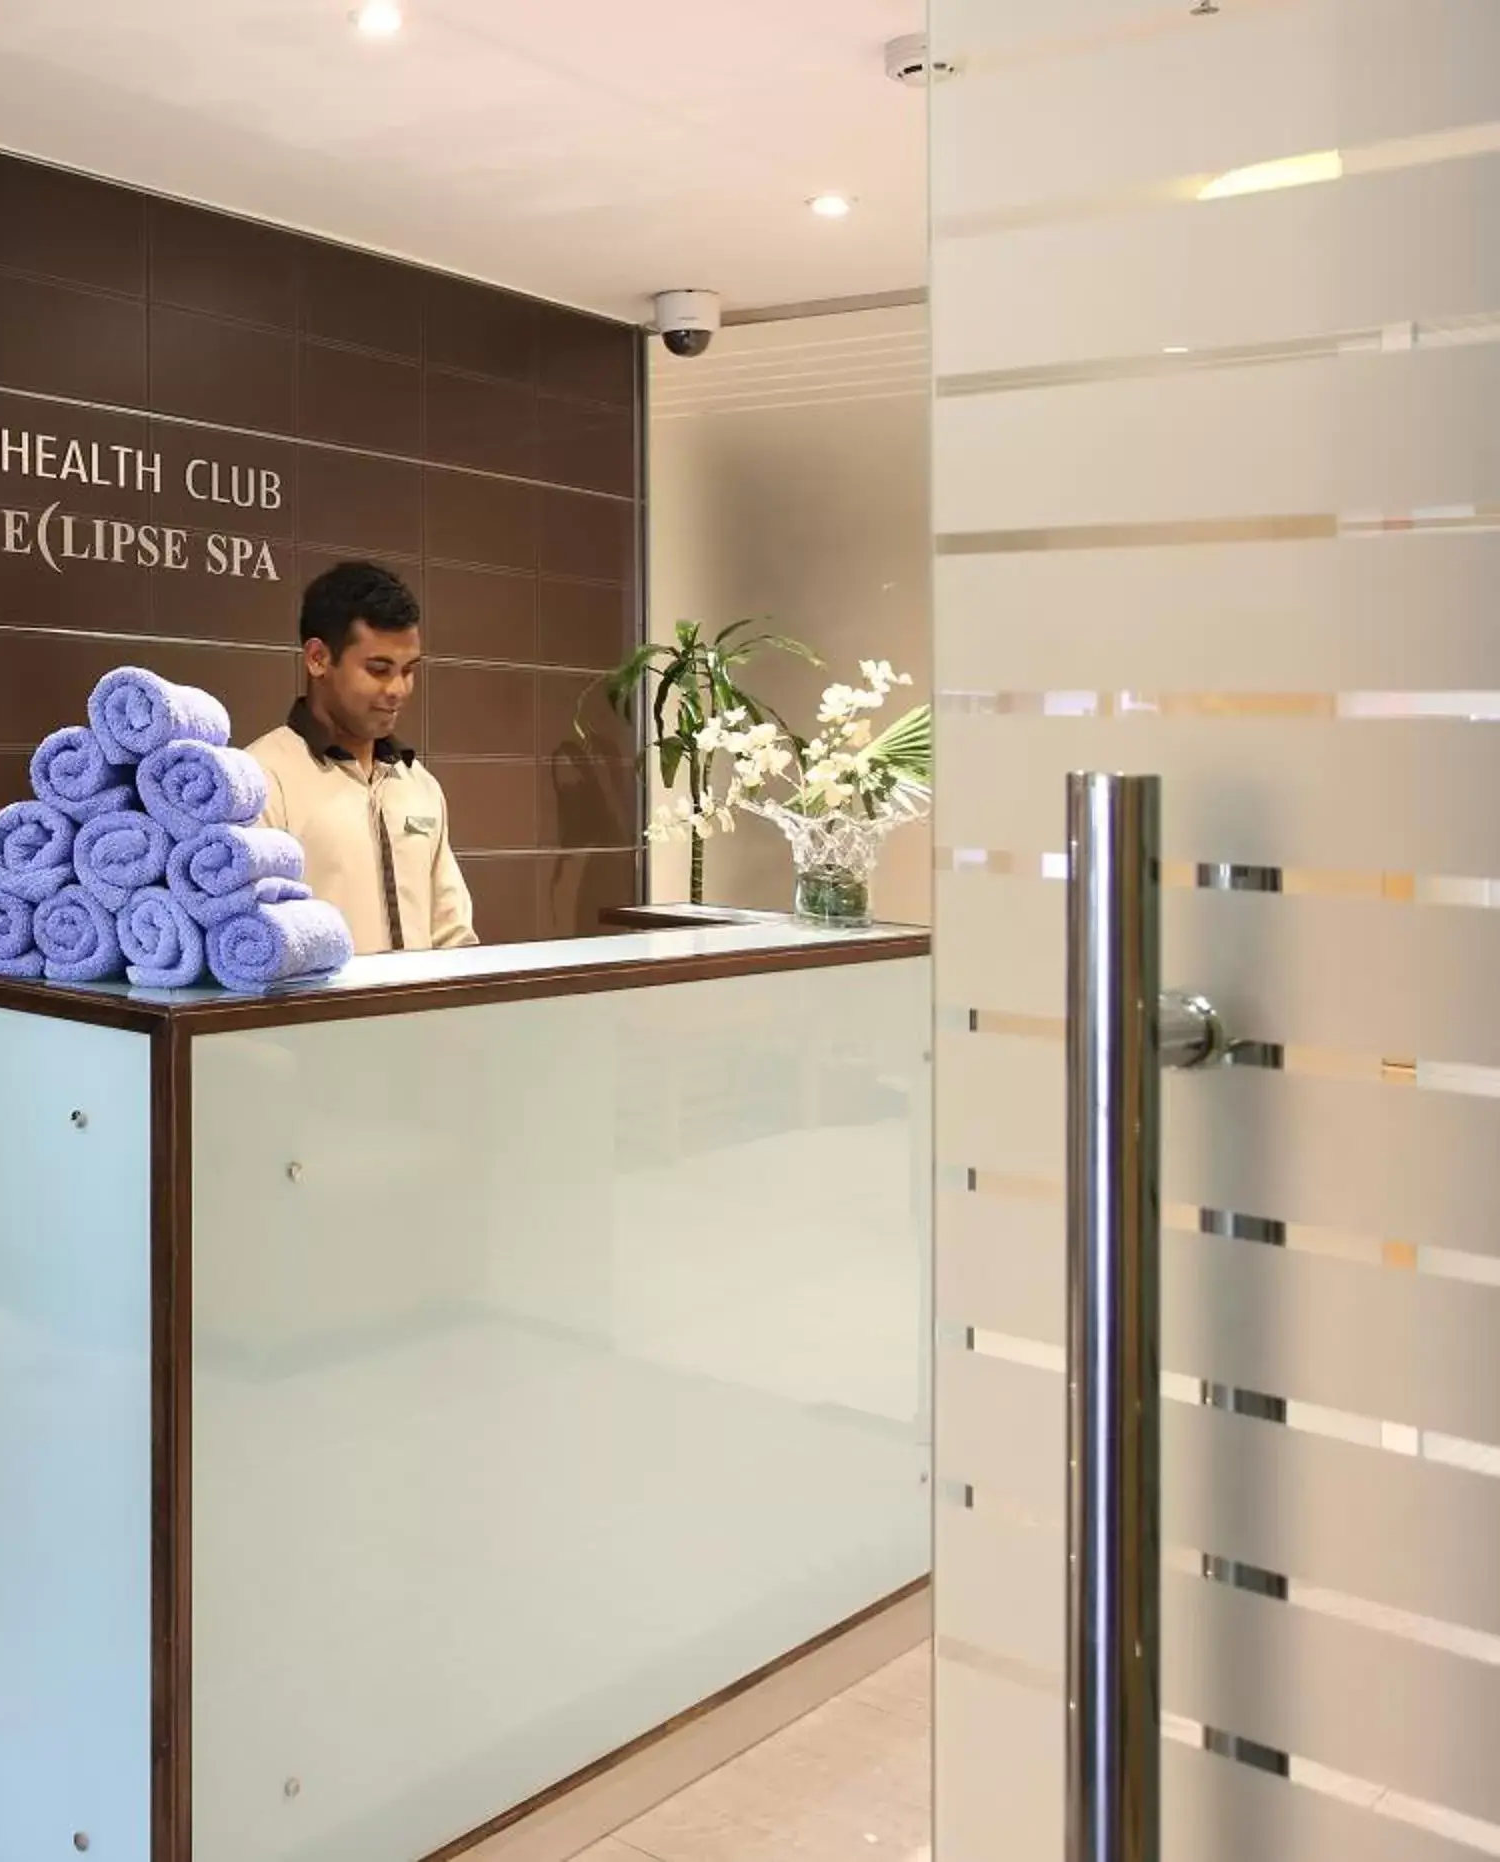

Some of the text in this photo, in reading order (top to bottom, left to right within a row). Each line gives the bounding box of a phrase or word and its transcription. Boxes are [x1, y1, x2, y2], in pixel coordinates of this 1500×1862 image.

[1, 428, 282, 510] HEALTH CLUB
[3, 501, 281, 581] ECLIPSE SPA
